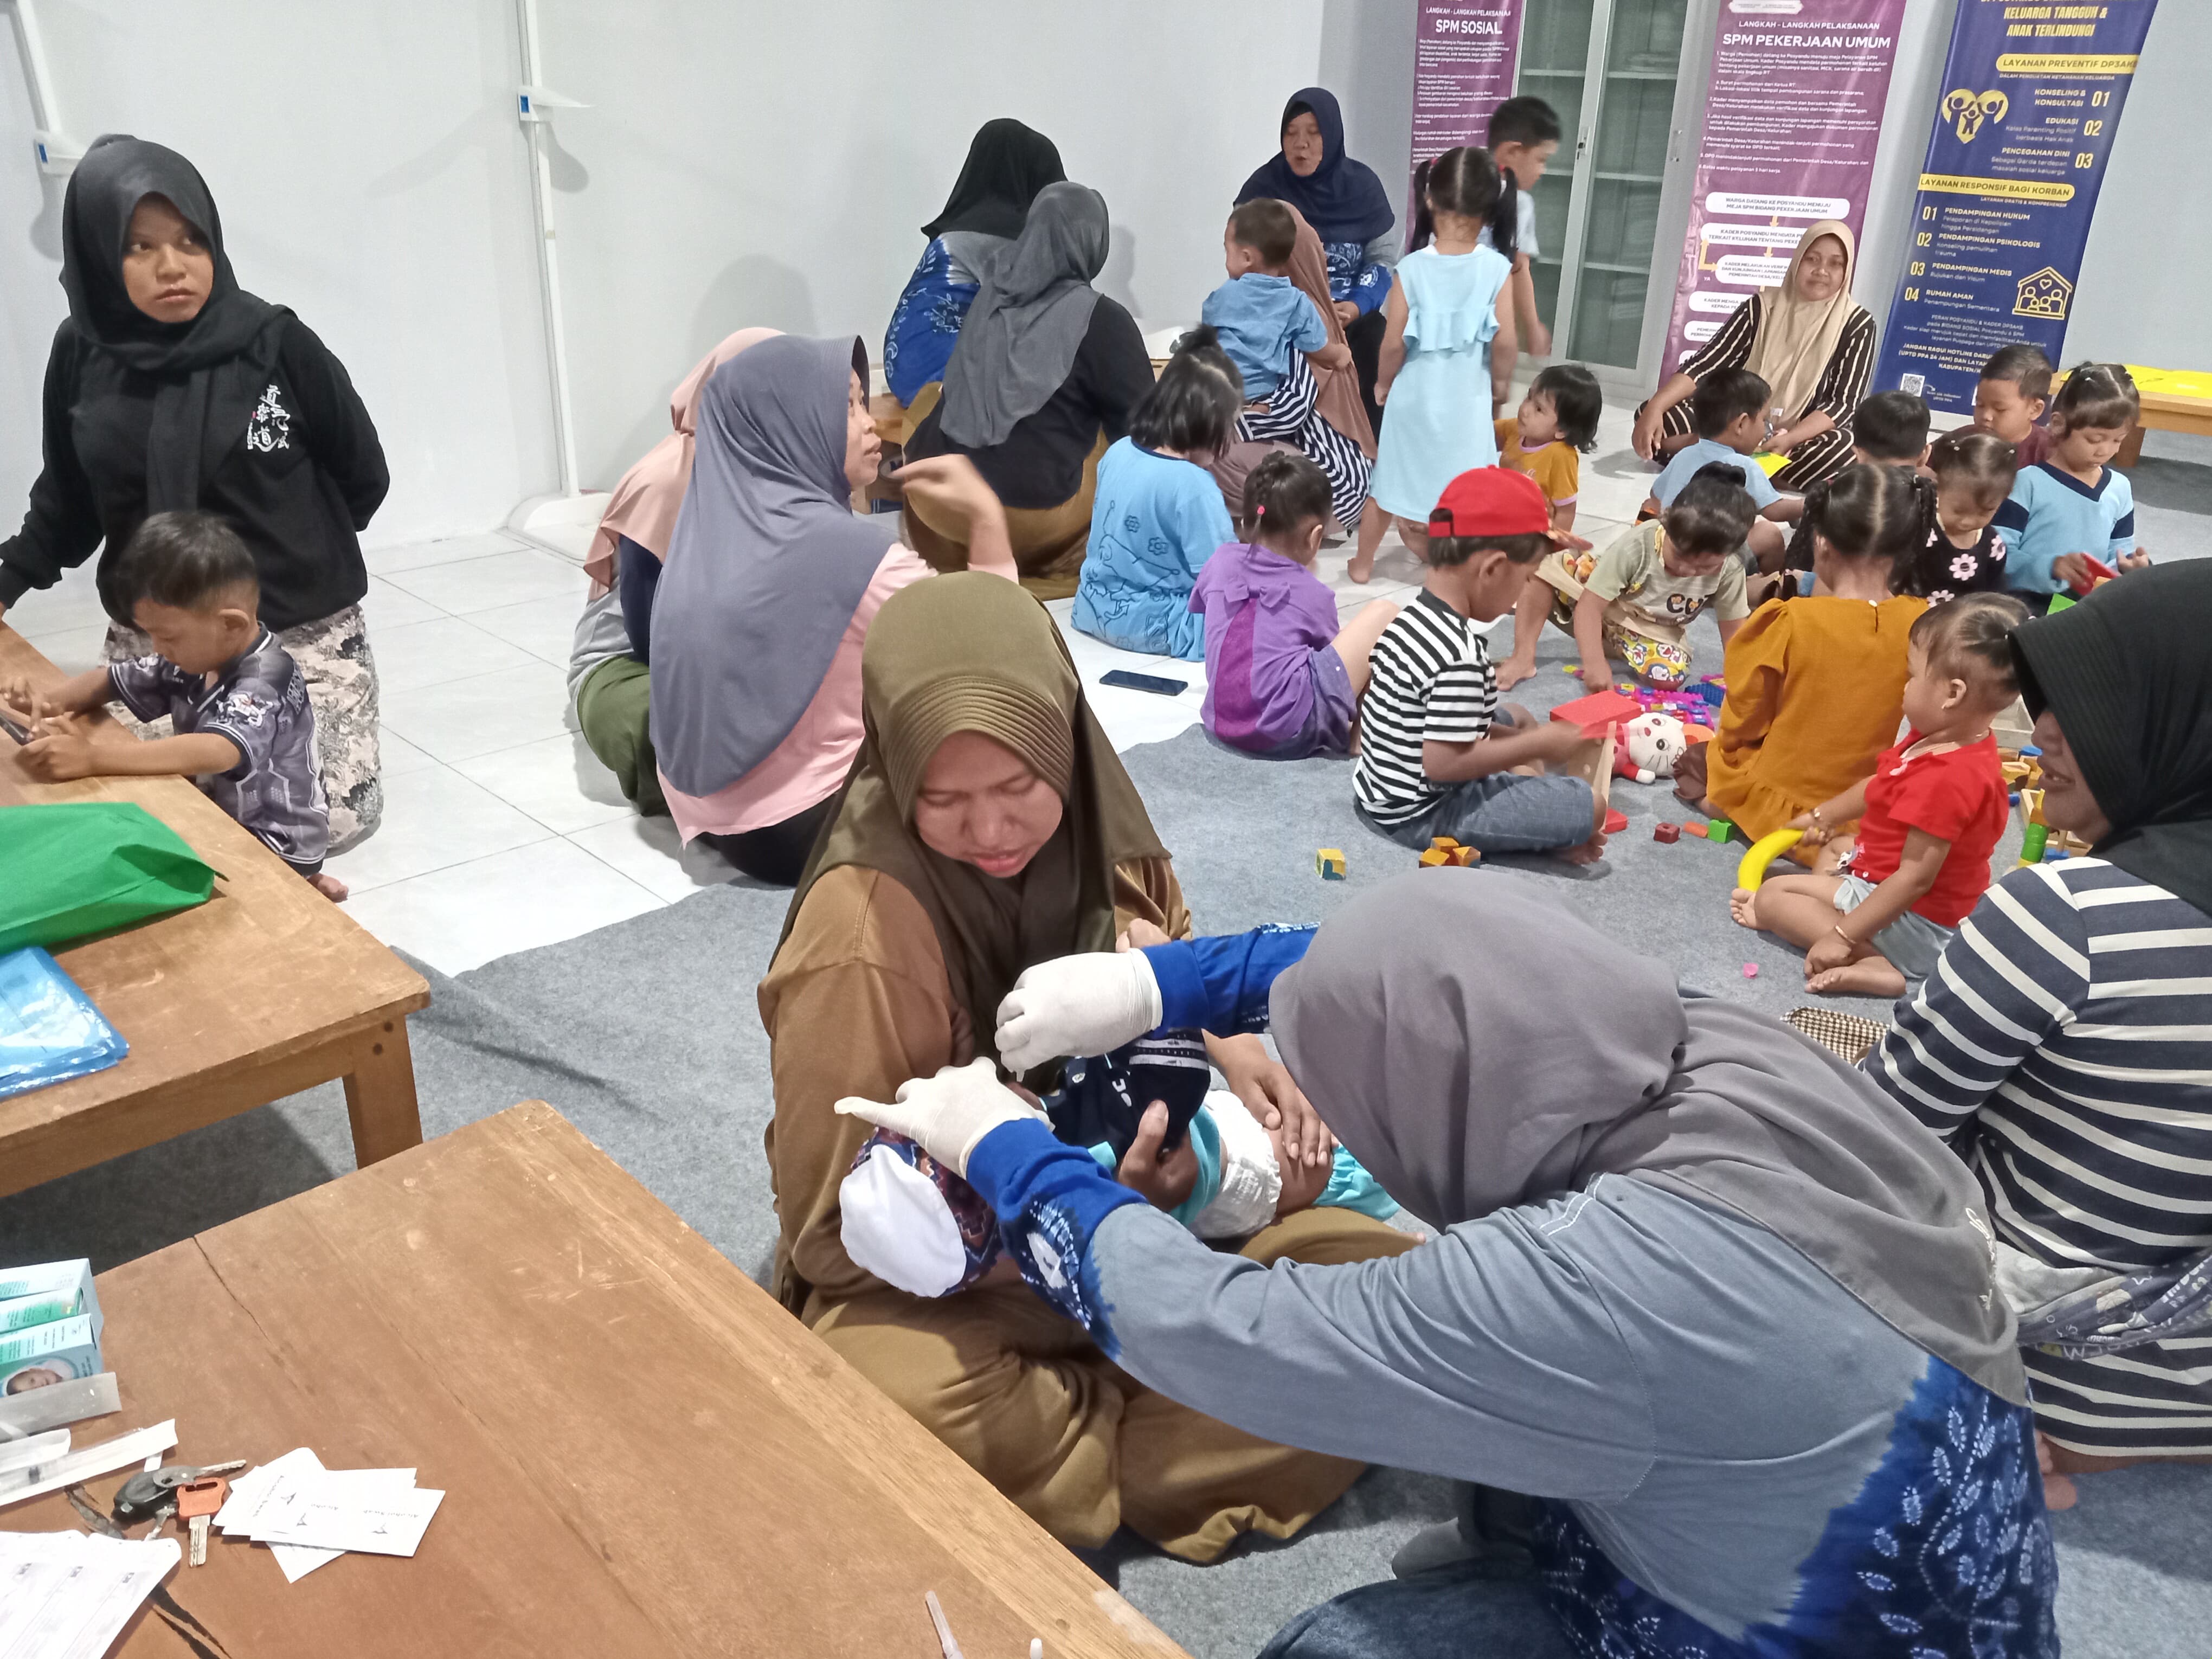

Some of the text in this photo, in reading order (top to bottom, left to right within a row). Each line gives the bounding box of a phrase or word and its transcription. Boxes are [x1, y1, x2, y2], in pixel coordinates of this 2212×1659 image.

[2003, 7, 2052, 19] KELUARGA
[2054, 6, 2099, 18] TANGGUH
[1436, 19, 1502, 34] SPM SOSIAL
[2006, 24, 2095, 36] ANAK TERLINDUNGI
[1722, 34, 1891, 48] SPM PEKERJAAN UMUM
[2091, 91, 2110, 106] 01
[2084, 120, 2102, 136] 02
[2002, 147, 2053, 156] PENCEGAHAN
[2075, 153, 2093, 168] 03
[1921, 179, 1958, 187] LAYANAN
[1960, 182, 2007, 190] RESPONSIF
[2032, 187, 2069, 195] KORBAN
[1922, 206, 1937, 220] 01
[1945, 207, 2001, 217] PENDAMPINGAN
[1917, 232, 1932, 246] 02
[1938, 233, 2040, 248] PENDAMPINGAN PSIKOLOGIS
[1910, 261, 1925, 275] 03
[1932, 262, 1988, 273] PENDAMPINGAN
[1905, 287, 1919, 301] 04
[1926, 289, 1951, 297] RUMAH
